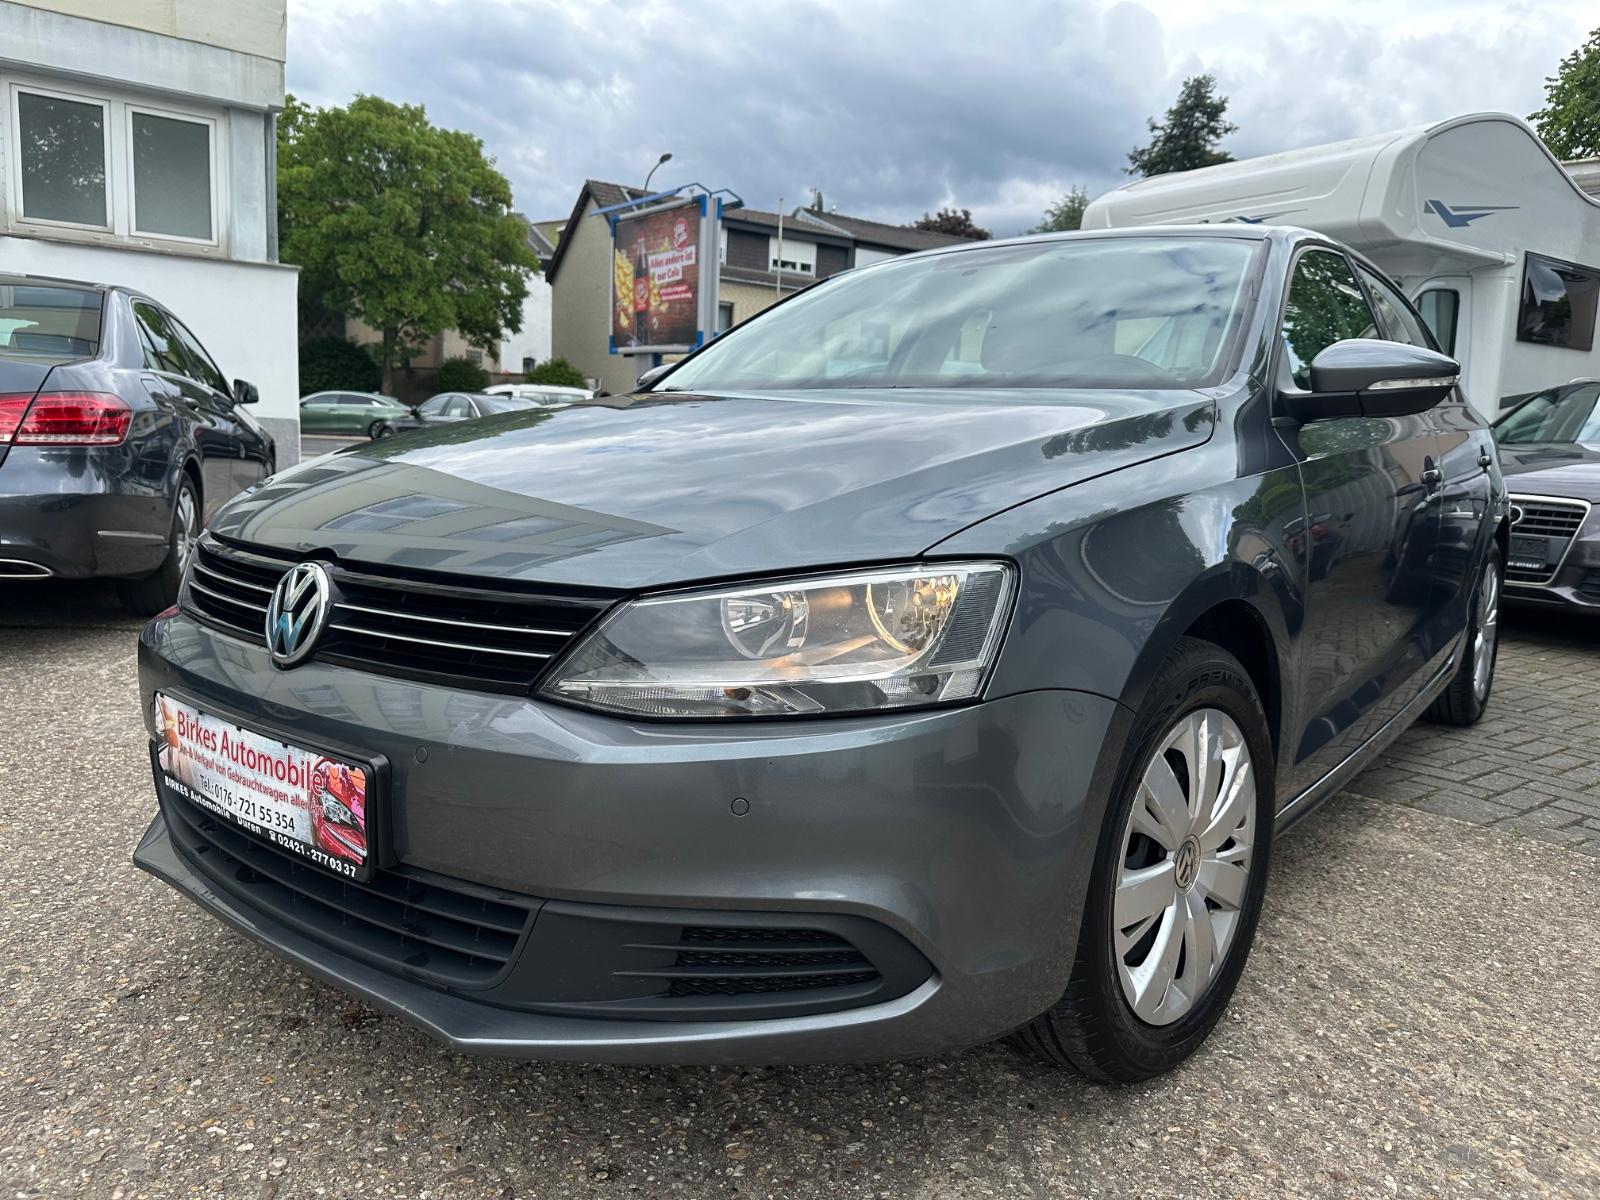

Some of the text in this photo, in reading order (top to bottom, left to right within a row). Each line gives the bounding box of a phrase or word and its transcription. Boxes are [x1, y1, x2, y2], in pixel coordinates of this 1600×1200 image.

[650, 250, 693, 269] Alles andere ist
[657, 268, 680, 281] nur Cola
[177, 710, 323, 796] Birkes Automobile
[215, 763, 226, 776] von
[227, 766, 288, 804] Gebrauchtwagen
[290, 792, 310, 811] aller
[274, 811, 295, 833] 354
[277, 834, 305, 855] 02421
